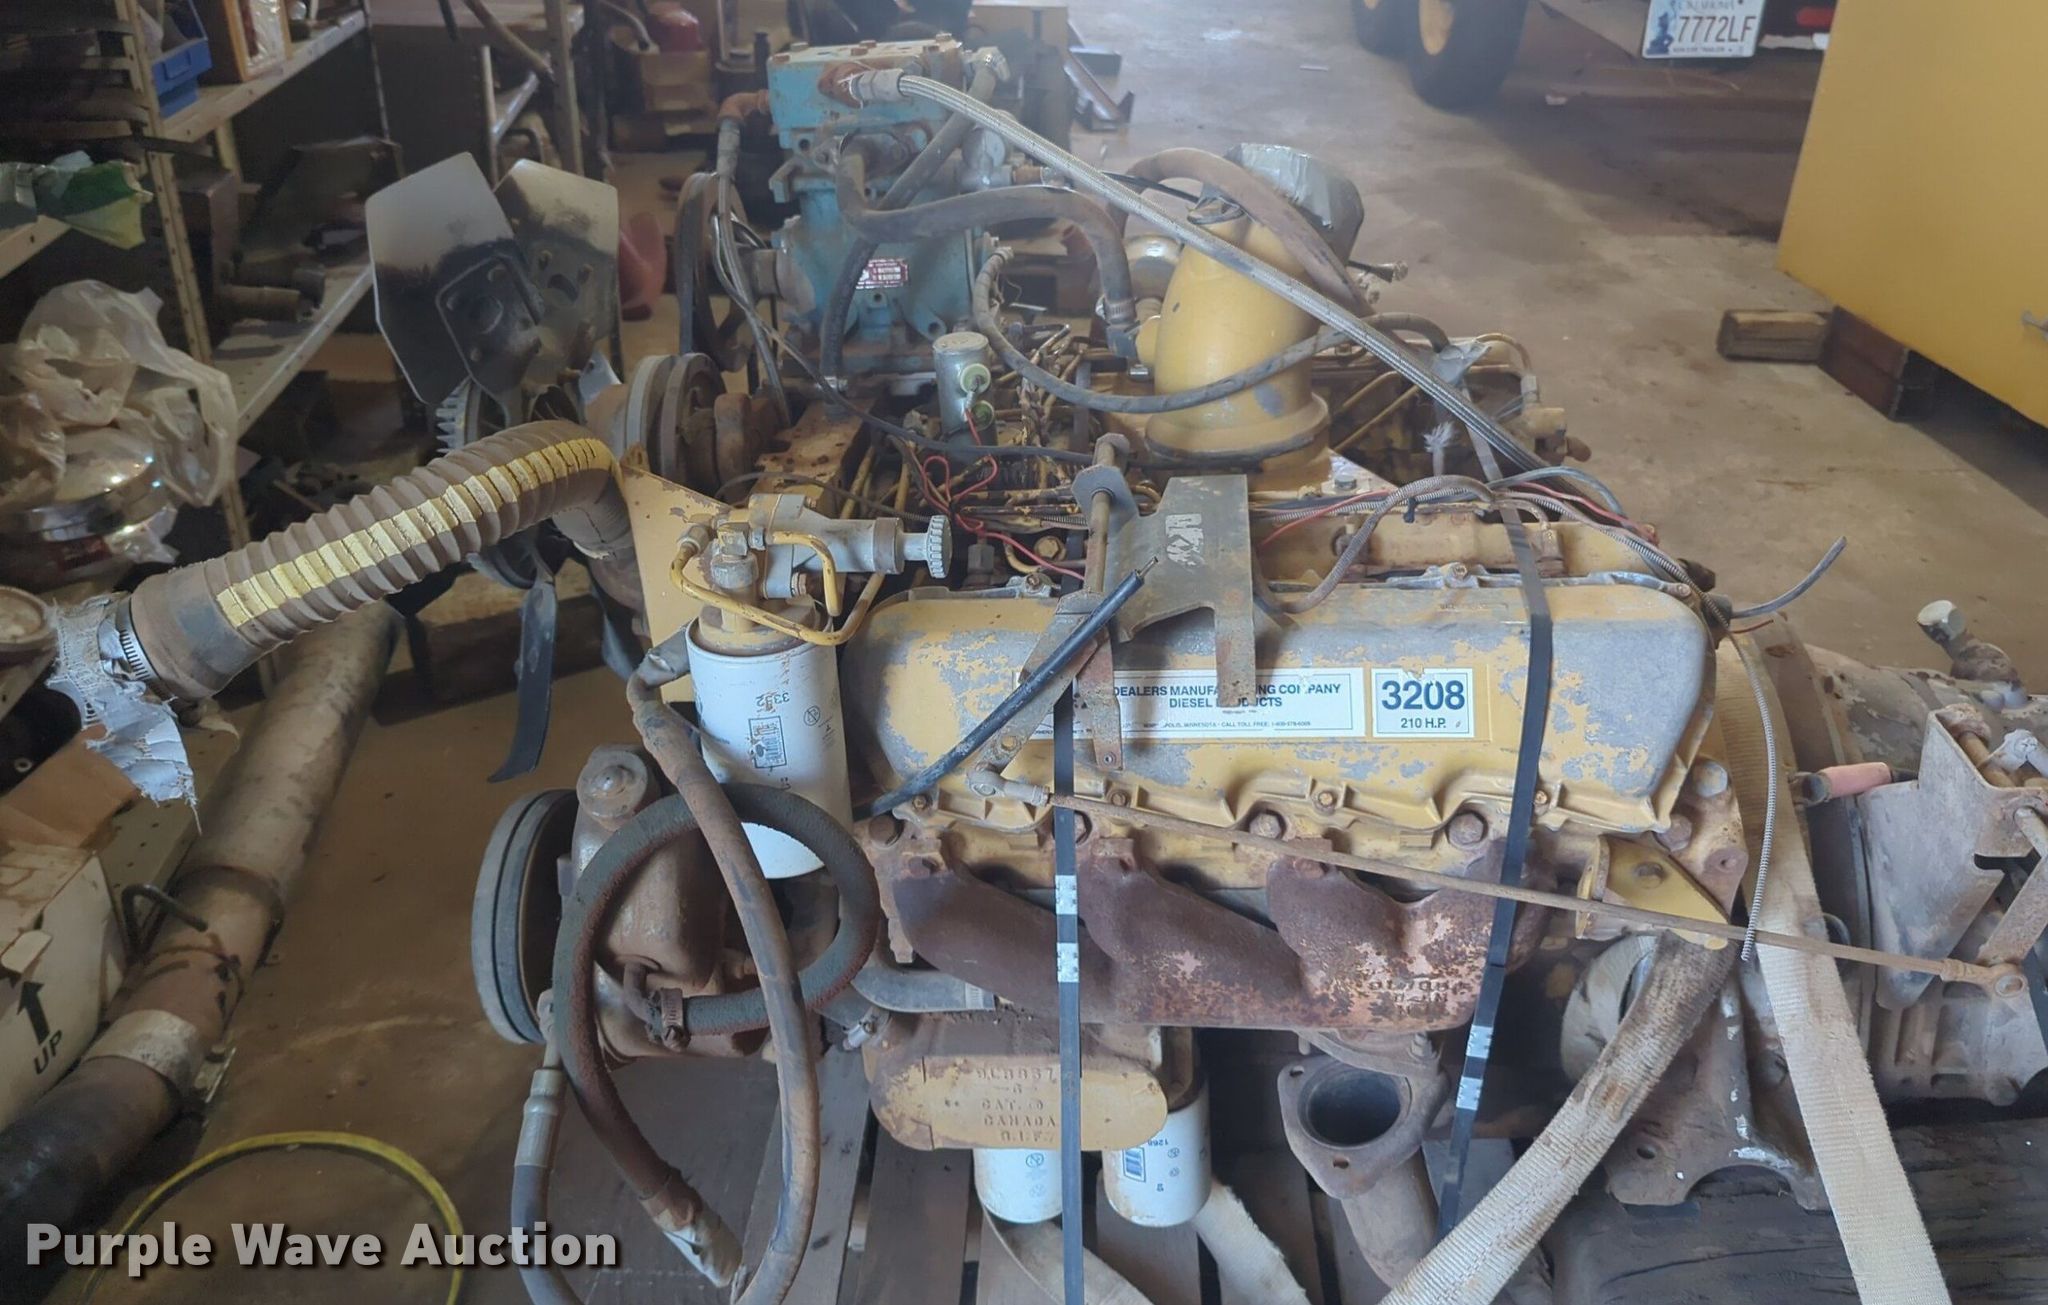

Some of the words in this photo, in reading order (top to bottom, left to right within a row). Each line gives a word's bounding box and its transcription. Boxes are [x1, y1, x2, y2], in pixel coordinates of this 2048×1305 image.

[1678, 15, 1757, 43] 7772LF
[1113, 685, 1168, 697] DEALERS
[1169, 684, 1276, 698] MANUFING
[1380, 677, 1466, 712] 3208
[1169, 697, 1213, 709] DIESEL
[1215, 696, 1283, 709] DCTS
[1400, 717, 1422, 729] 210
[1424, 717, 1447, 729] H.P.
[33, 1029, 63, 1076] UP
